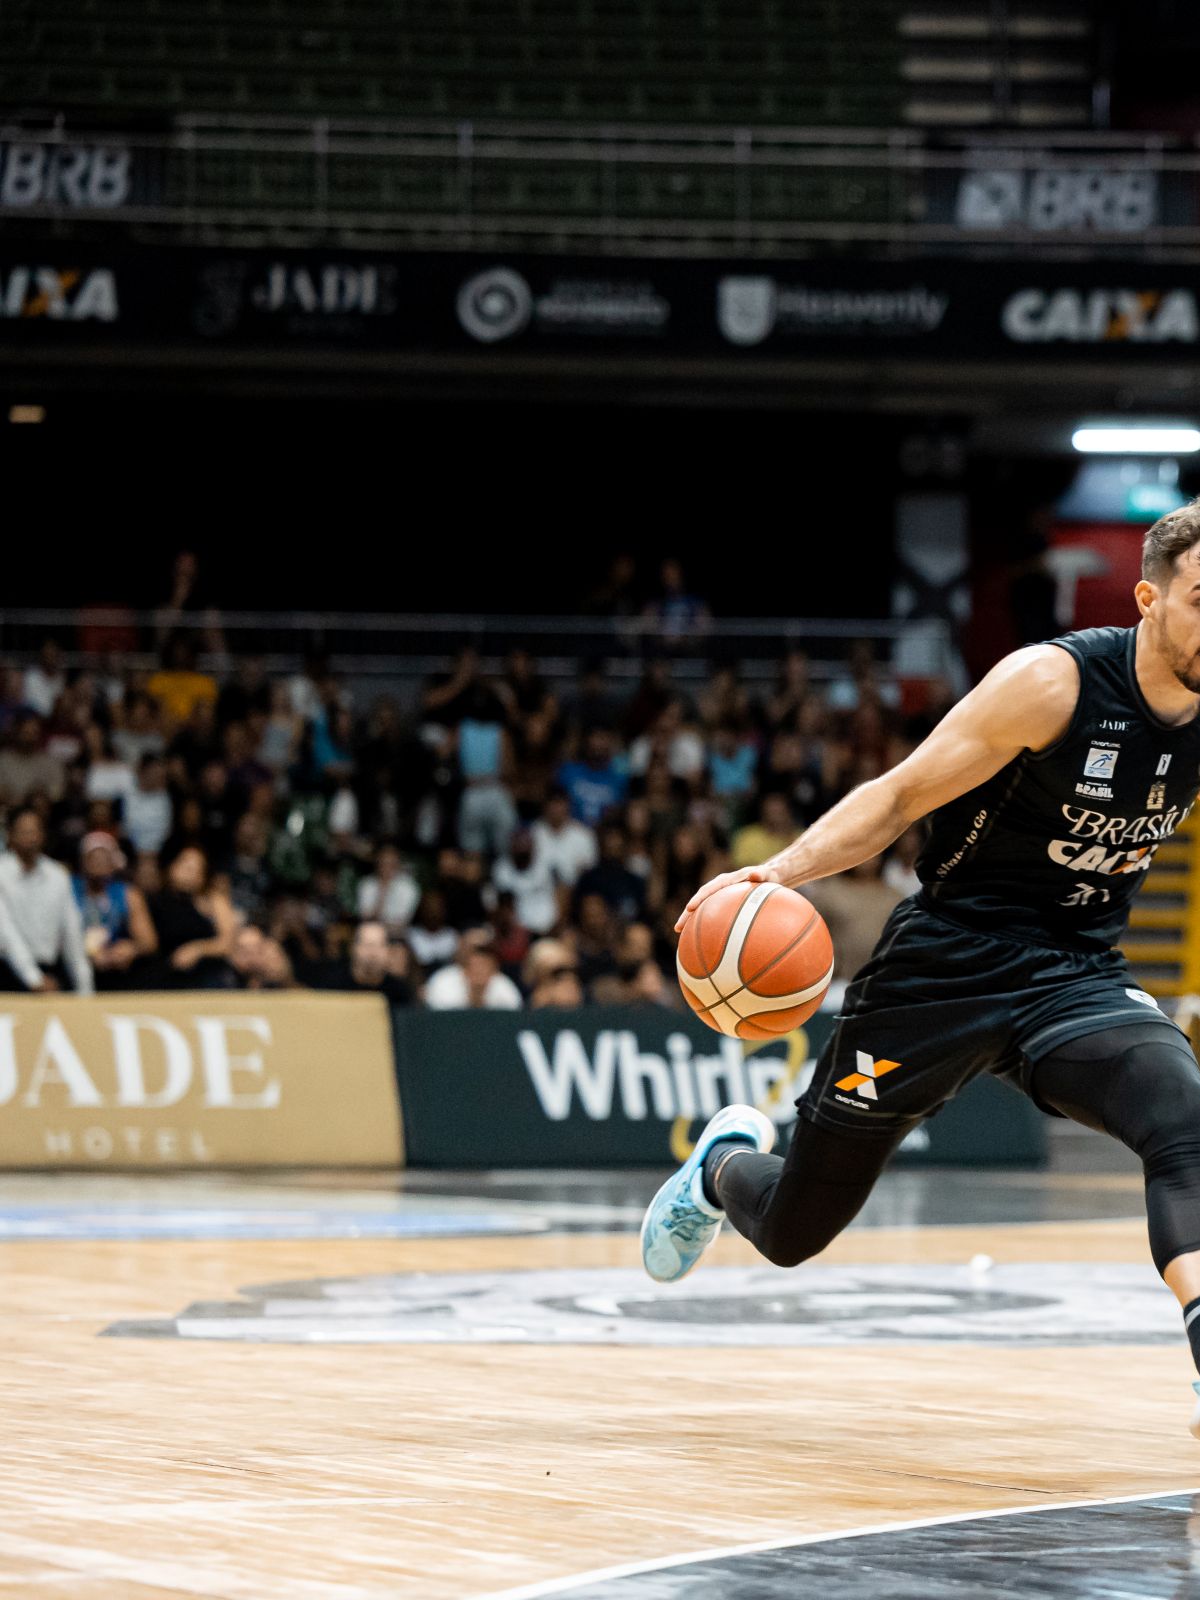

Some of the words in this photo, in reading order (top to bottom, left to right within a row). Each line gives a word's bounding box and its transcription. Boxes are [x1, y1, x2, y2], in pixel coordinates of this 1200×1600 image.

[2, 144, 131, 208] BRB
[1099, 719, 1131, 731] JADE
[973, 809, 987, 829] Go
[44, 1127, 212, 1163] HOTEL
